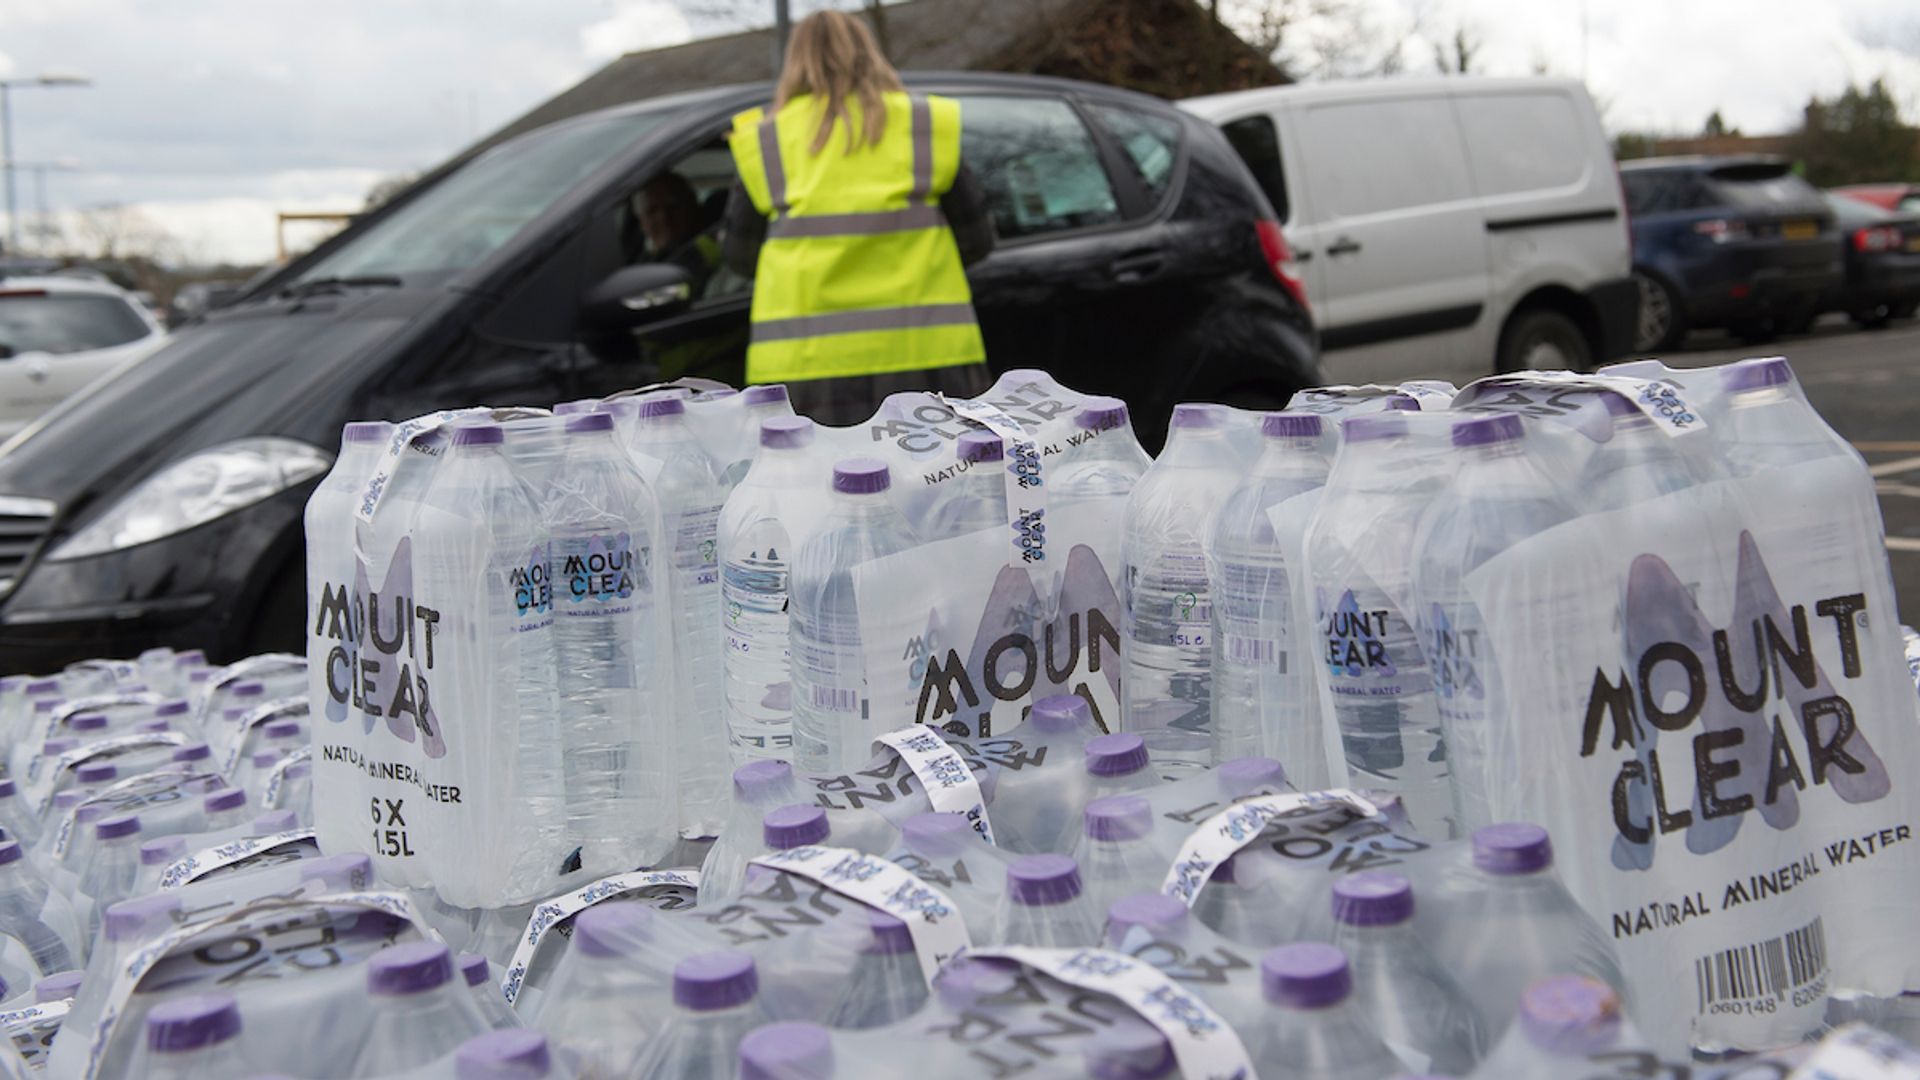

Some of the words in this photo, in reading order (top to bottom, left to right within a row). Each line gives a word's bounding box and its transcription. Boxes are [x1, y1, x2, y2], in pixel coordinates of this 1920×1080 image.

[1066, 414, 1119, 447] WATER
[1013, 438, 1028, 489] MOUNT
[1025, 441, 1041, 486] CLEAR
[1019, 508, 1032, 564] MOUNT
[1030, 510, 1043, 561] CLEAR
[915, 608, 1120, 724] MOUN
[1581, 593, 1866, 757] MOUNT
[424, 778, 462, 803] ATER
[1611, 695, 1866, 844] CLEAR
[371, 796, 382, 824] 6
[385, 799, 406, 826] X
[372, 829, 415, 857] 1.5L
[1613, 892, 1711, 939] NATURAL
[1722, 853, 1820, 911] MINERAL
[1824, 824, 1912, 867] WATER
